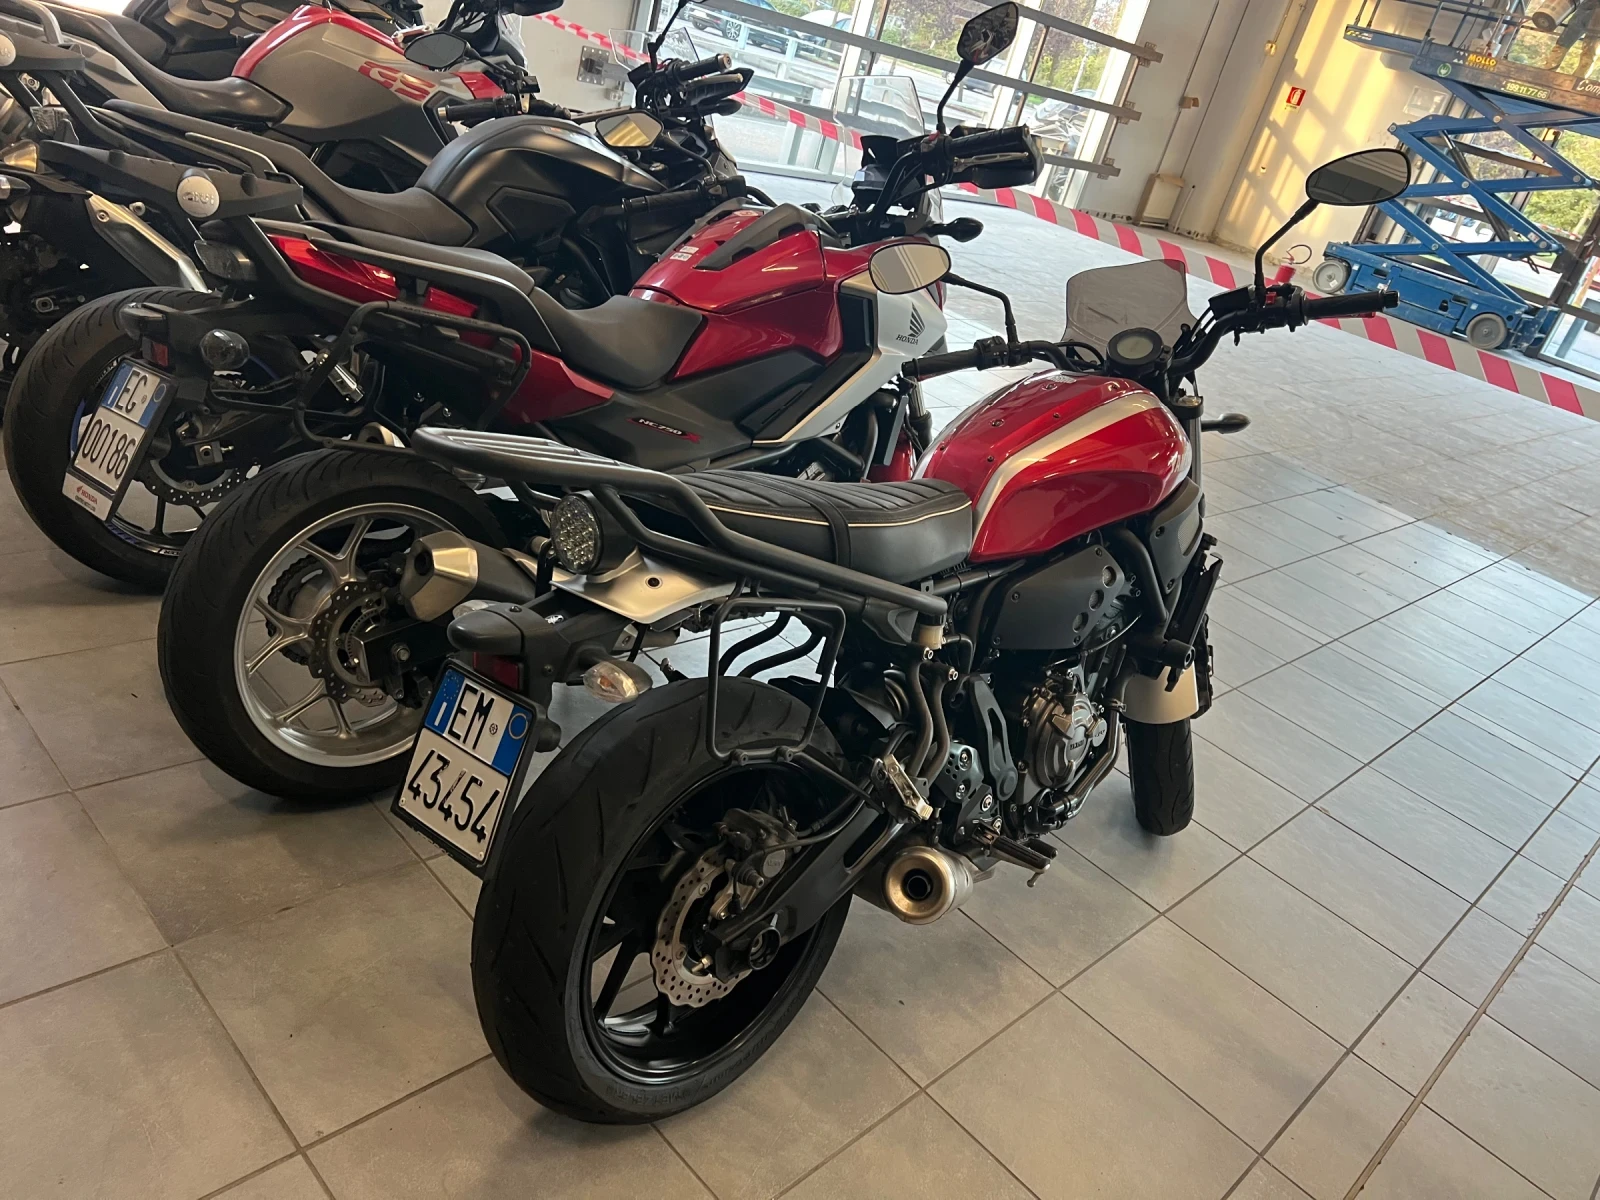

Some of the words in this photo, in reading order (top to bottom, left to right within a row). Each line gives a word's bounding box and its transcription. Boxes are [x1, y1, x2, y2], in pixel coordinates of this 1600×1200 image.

[358, 61, 436, 102] GS
[1467, 54, 1497, 67] MOLLO
[896, 333, 919, 346] HONDA
[81, 418, 137, 480] 00186
[448, 683, 495, 750] EM
[407, 749, 500, 844] 43454
